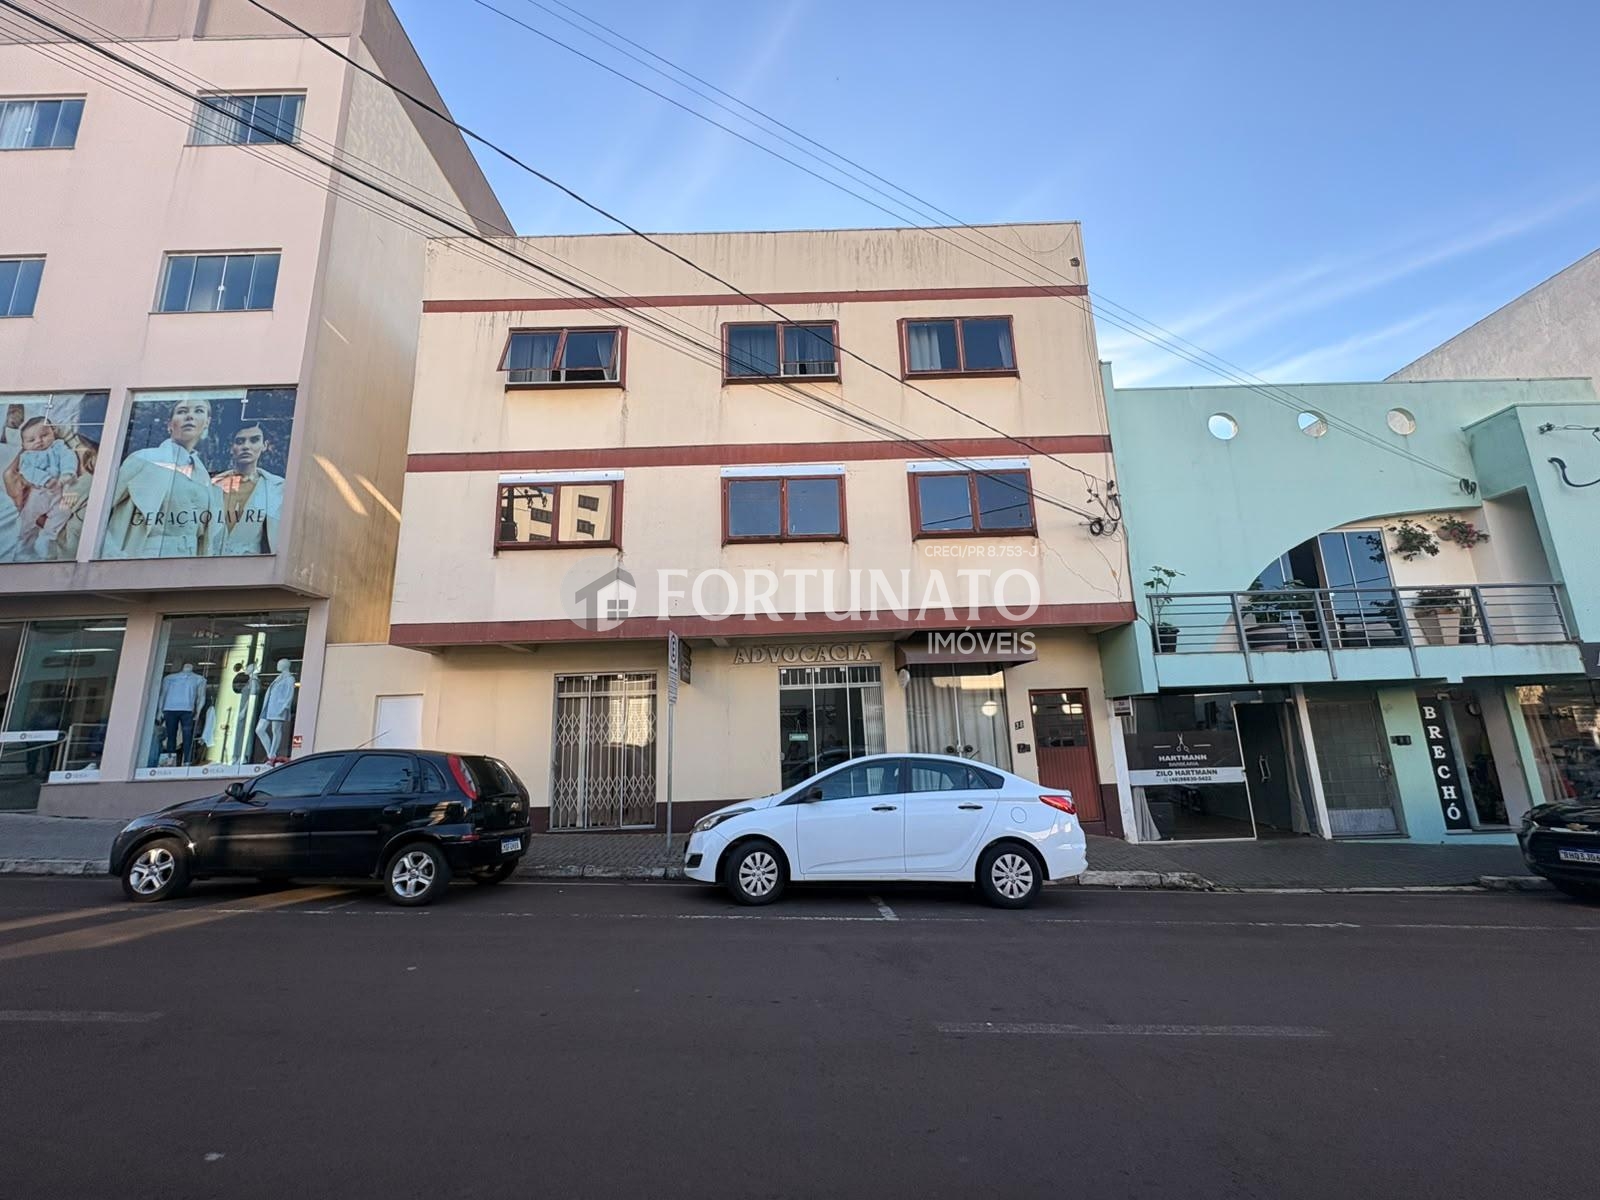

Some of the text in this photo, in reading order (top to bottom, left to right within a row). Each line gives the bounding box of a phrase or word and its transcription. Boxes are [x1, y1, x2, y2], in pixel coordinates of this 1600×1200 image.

[130, 507, 266, 527] GERAÇÃO LIVRE
[733, 643, 873, 664] ADVOCACIA
[1158, 754, 1207, 762] HARTMANN
[1422, 706, 1461, 820] BRECHÓ
[1175, 768, 1218, 776] HARTMANN
